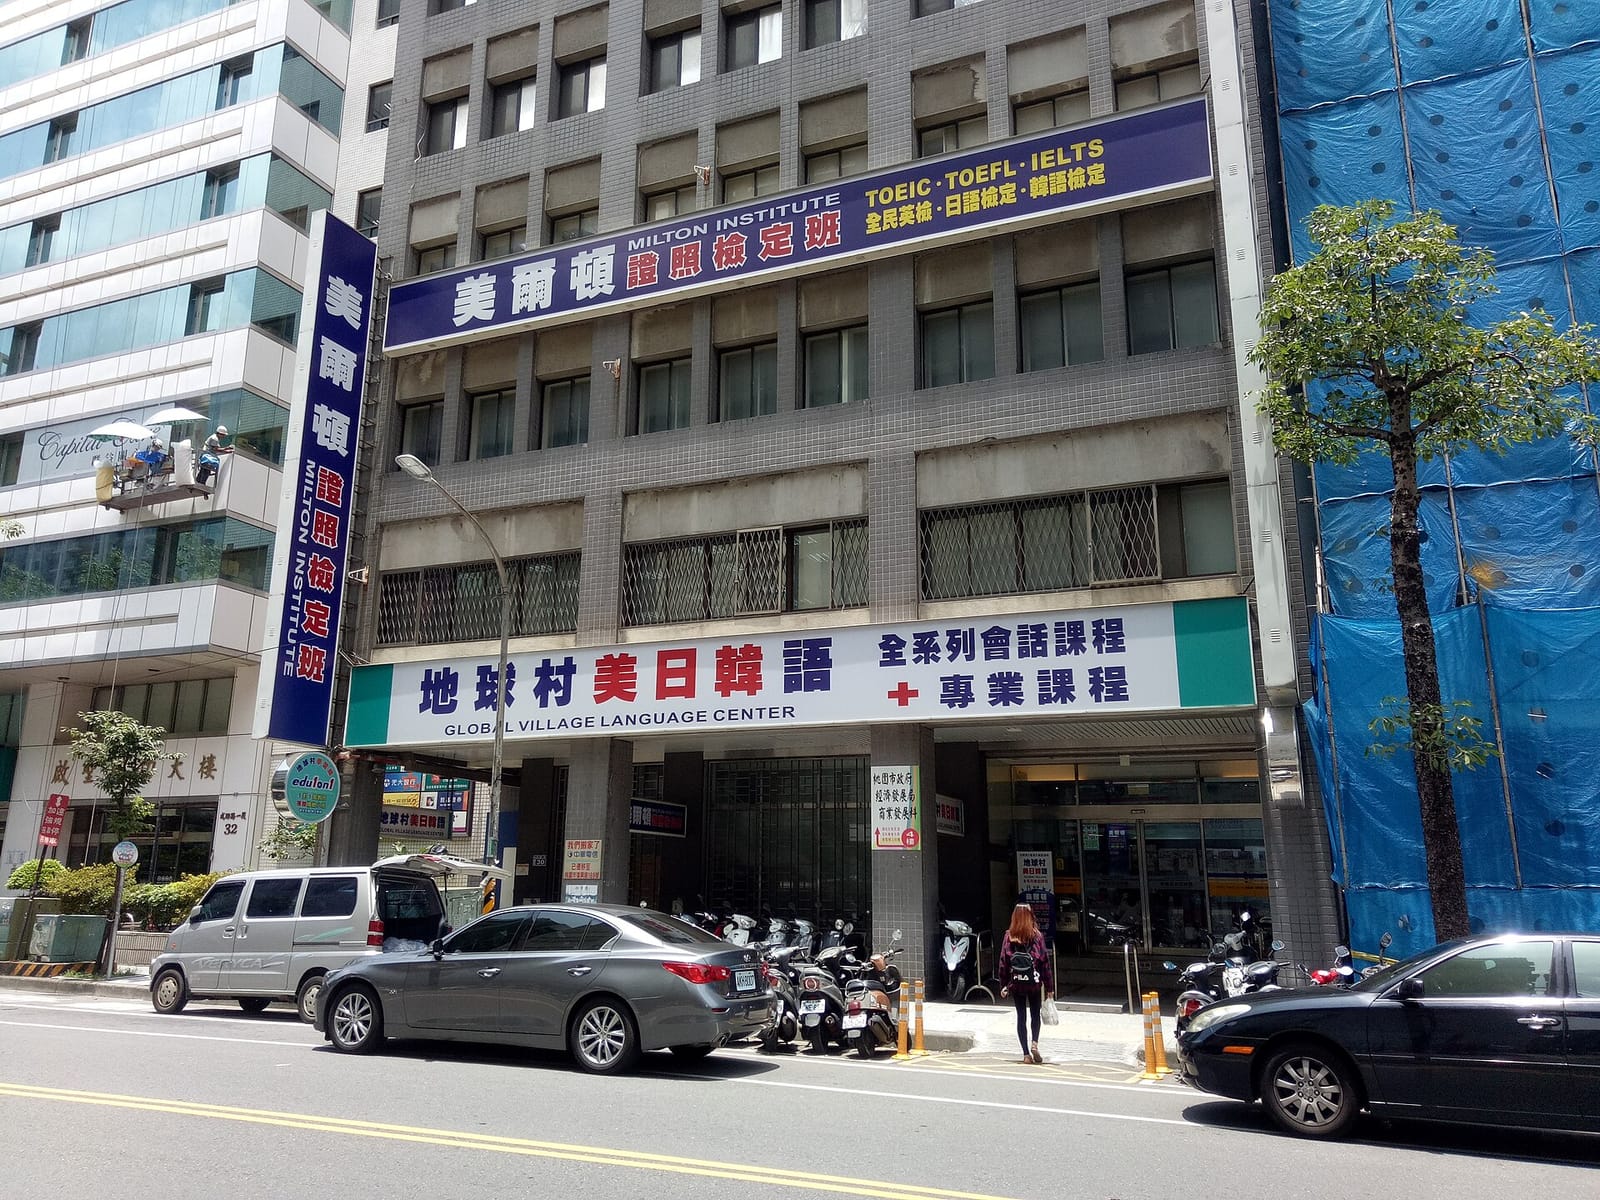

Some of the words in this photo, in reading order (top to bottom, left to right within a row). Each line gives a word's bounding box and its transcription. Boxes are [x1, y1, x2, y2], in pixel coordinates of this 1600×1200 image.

[865, 178, 931, 208] TOEIC
[945, 159, 1017, 190] TOEFL
[1031, 138, 1105, 171] IELTS
[625, 211, 843, 290] 證照檢定班
[628, 223, 708, 252] MILTON
[715, 192, 841, 231] INSTITUTE
[452, 245, 615, 327] 美爾頓
[312, 274, 363, 457] 美爾頓
[298, 459, 316, 544] MILTON
[296, 465, 345, 684] 證照檢定班
[283, 550, 306, 677] INSTITUTE
[877, 617, 1126, 668] 全系列會話課程
[939, 665, 1129, 710] 專業課程
[444, 718, 514, 737] GLOBL
[519, 715, 596, 733] VILLAGE
[600, 709, 707, 729] LANGUAGE
[713, 705, 795, 723] CENTER
[873, 772, 912, 785] 桃園市政府
[876, 789, 916, 802] 經濟發展局
[224, 823, 238, 836] 32
[879, 806, 917, 820] 商業發展科
